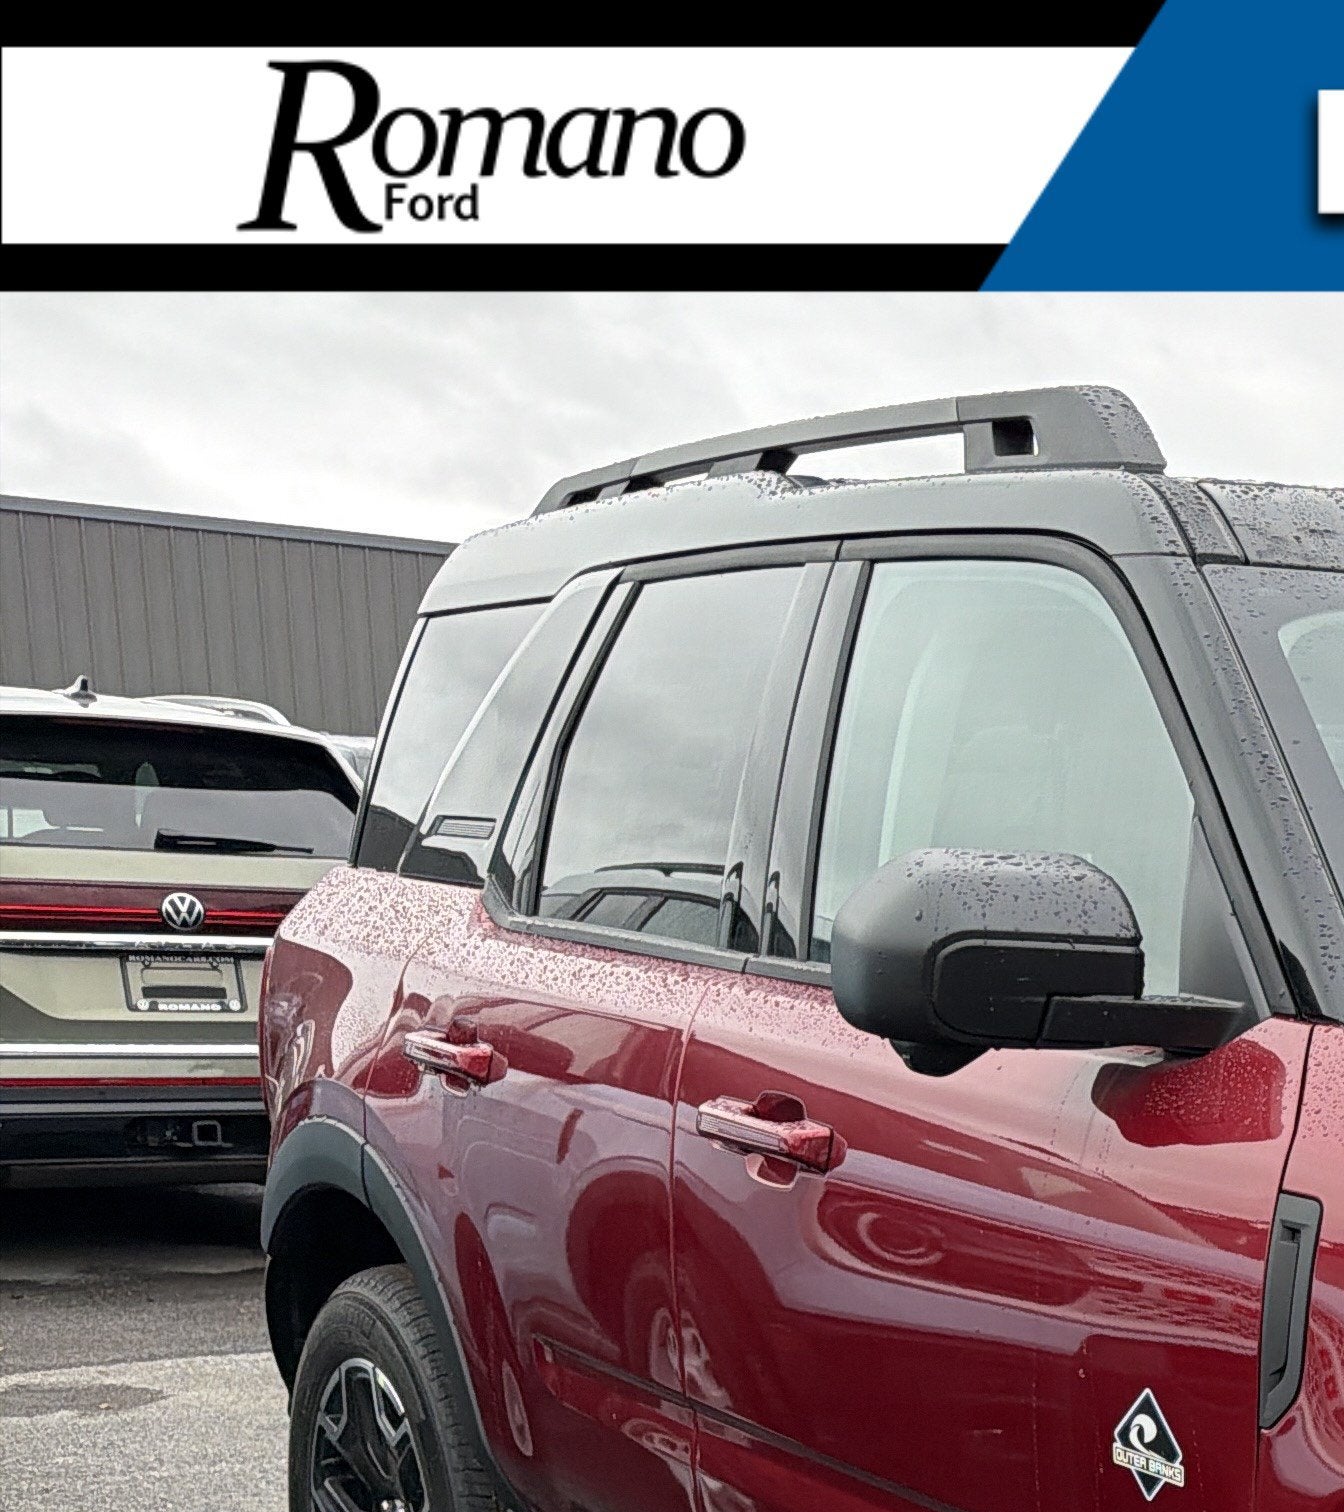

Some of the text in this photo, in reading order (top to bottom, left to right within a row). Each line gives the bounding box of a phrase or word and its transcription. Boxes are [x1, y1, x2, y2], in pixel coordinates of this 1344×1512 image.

[158, 1003, 222, 1012] ROMANO
[1115, 1447, 1181, 1482] OUTER BANKS
